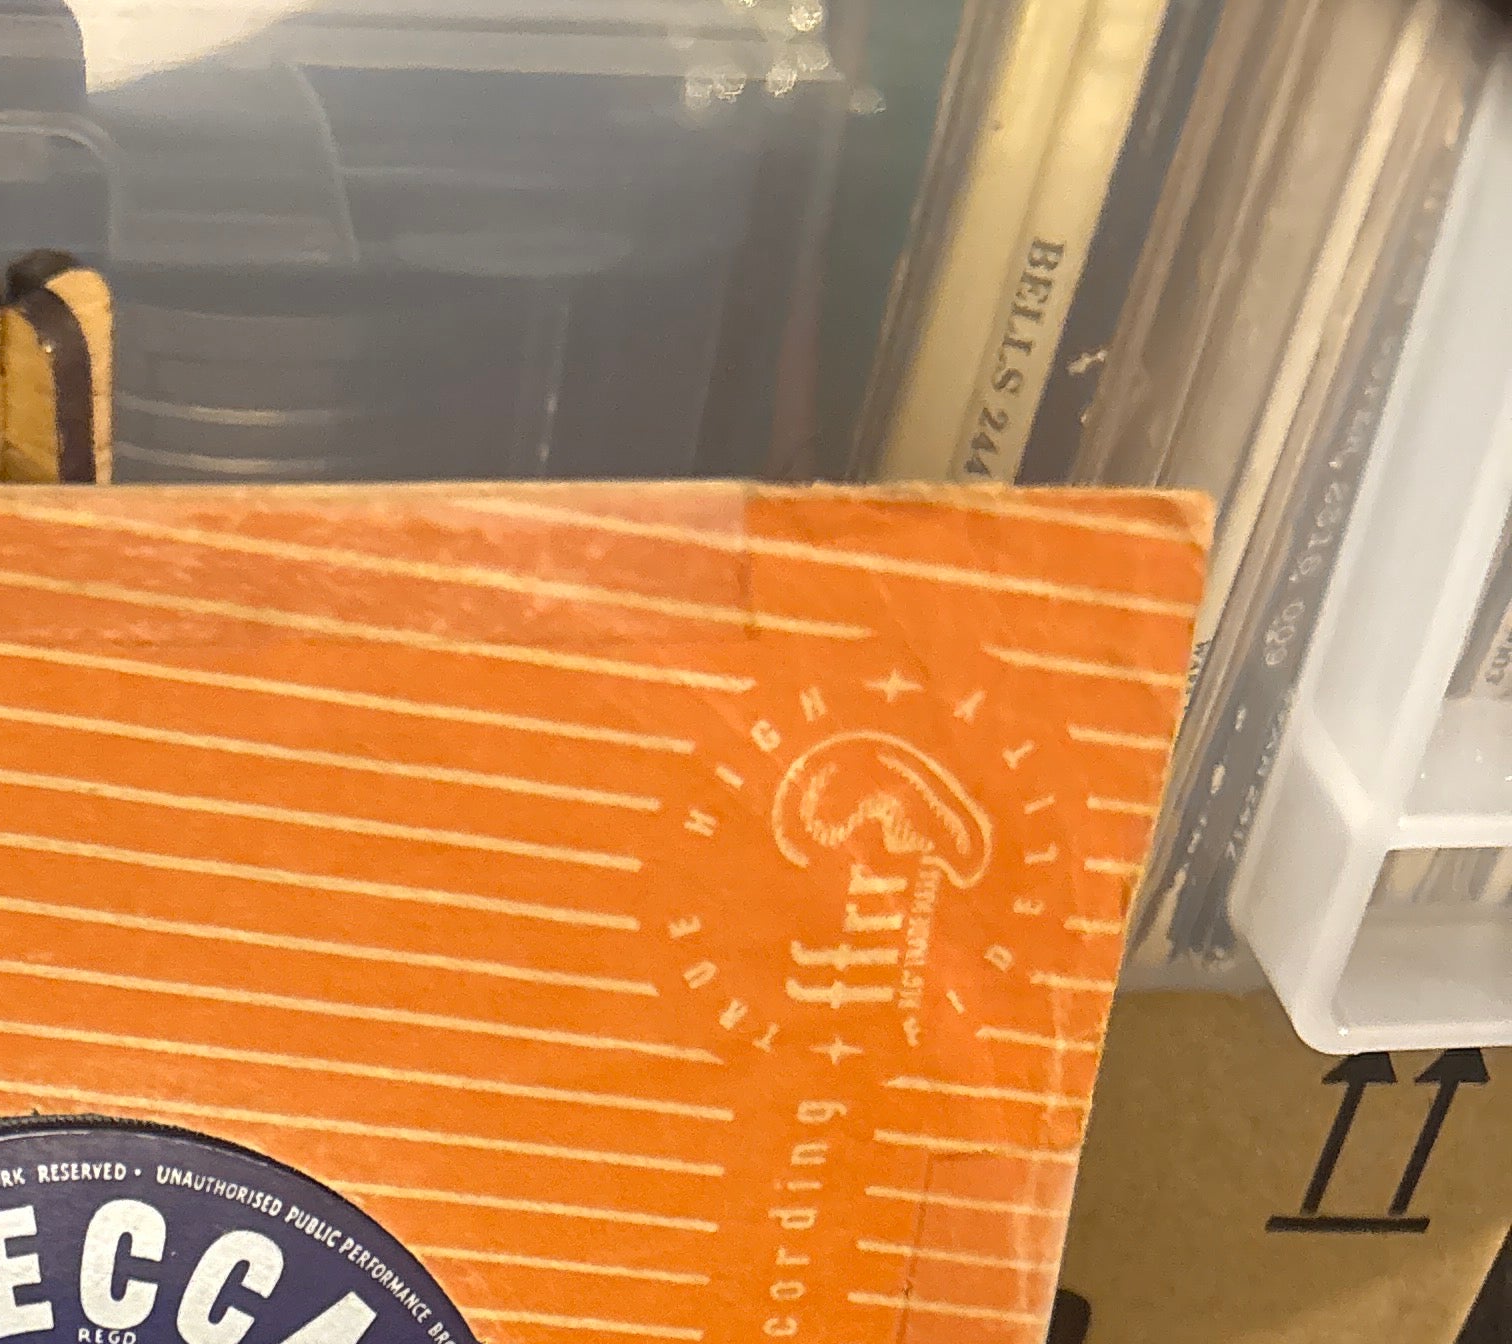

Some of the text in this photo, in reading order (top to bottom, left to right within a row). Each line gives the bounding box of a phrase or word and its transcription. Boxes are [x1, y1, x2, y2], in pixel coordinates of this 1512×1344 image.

[991, 237, 1066, 395] BELLS
[684, 685, 827, 837] HIGH
[786, 864, 908, 1008] ffrr
[37, 1162, 127, 1183] RESERVED
[156, 1165, 283, 1217] UNAUTHORISED
[284, 1205, 343, 1248] PUBLIC
[338, 1237, 432, 1324] PERFORMANCE
